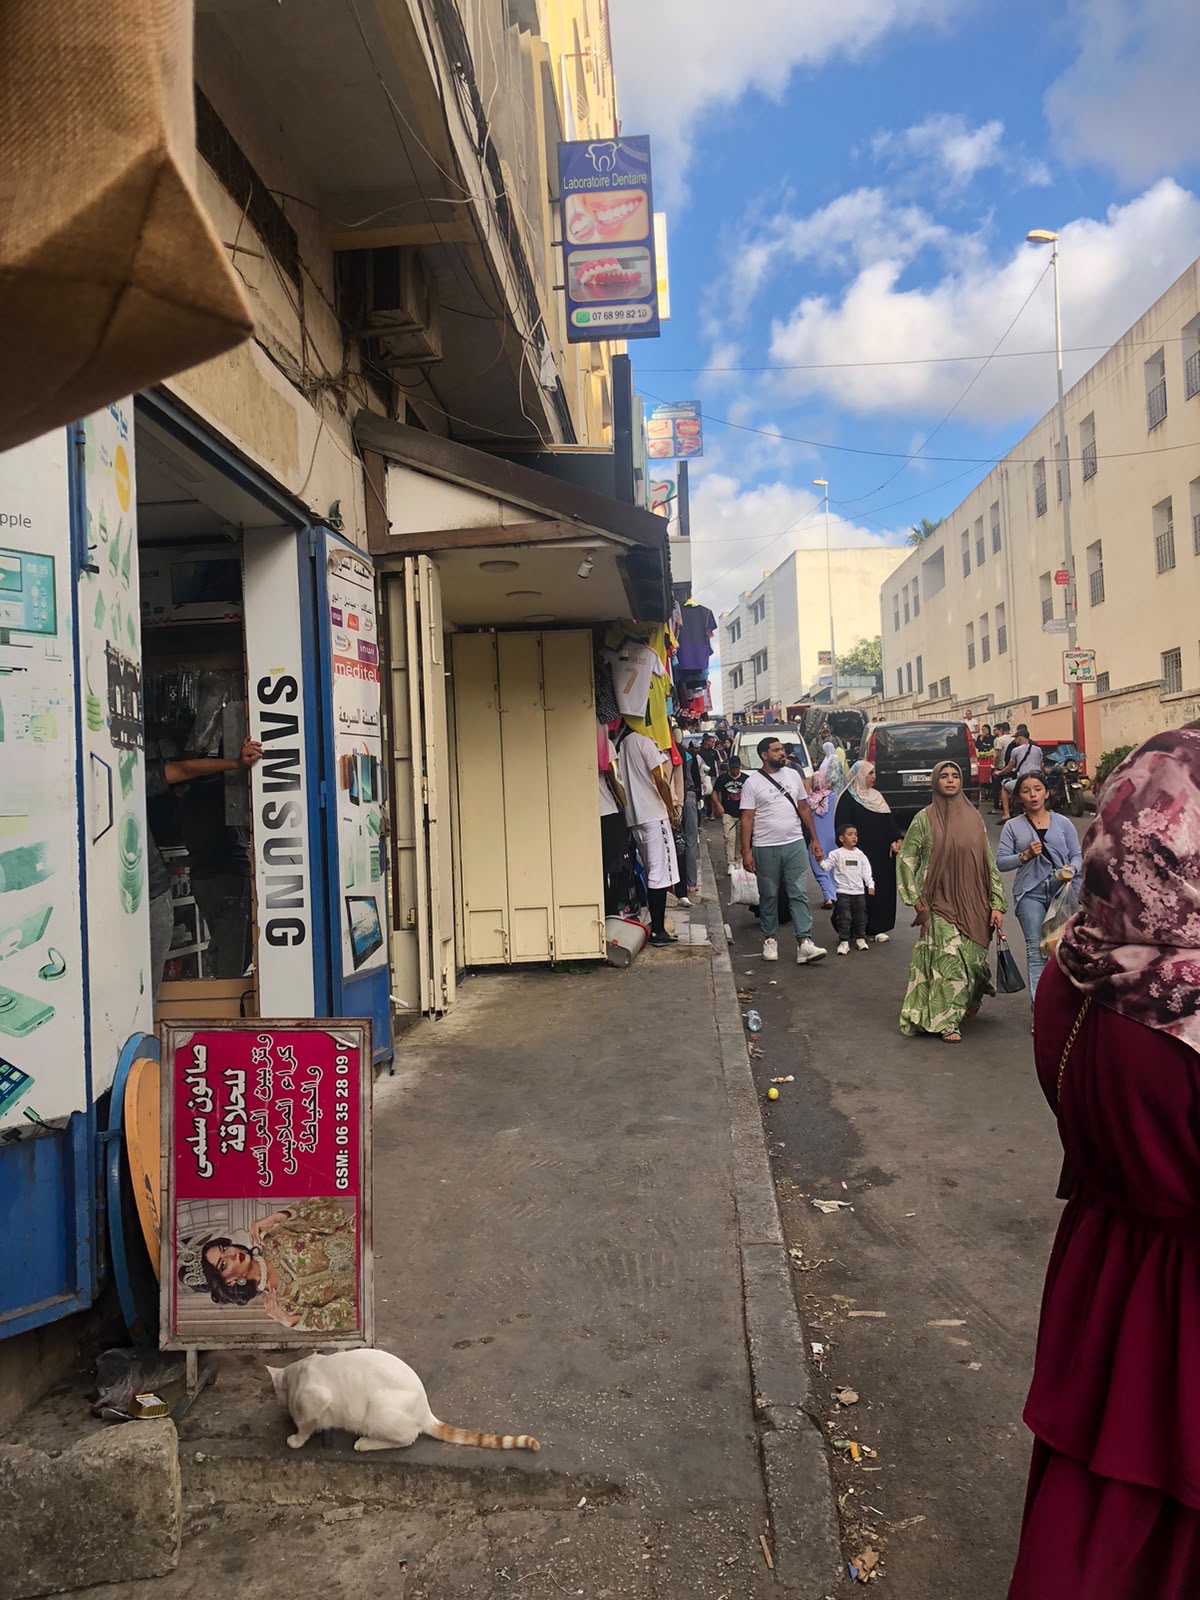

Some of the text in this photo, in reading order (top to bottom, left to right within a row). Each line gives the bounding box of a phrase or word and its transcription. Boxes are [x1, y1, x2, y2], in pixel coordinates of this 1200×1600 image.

[563, 172, 647, 190] Laboratoire Dentaire
[592, 308, 648, 321] 07 68 99 82 10
[623, 667, 639, 694] 7
[256, 674, 306, 947] SAMSUNG
[335, 1055, 349, 1074] 09
[335, 1078, 349, 1098] 28
[184, 1044, 214, 1178] صالون سلمى
[218, 1068, 248, 1155] للحلاقة
[249, 1034, 274, 1187] وتزيين العرائس
[275, 1045, 298, 1175] كراء الملابس
[298, 1065, 323, 1153] والخياطة
[335, 1102, 349, 1121] 35
[335, 1126, 349, 1145] 06
[335, 1149, 349, 1189] GSM:
